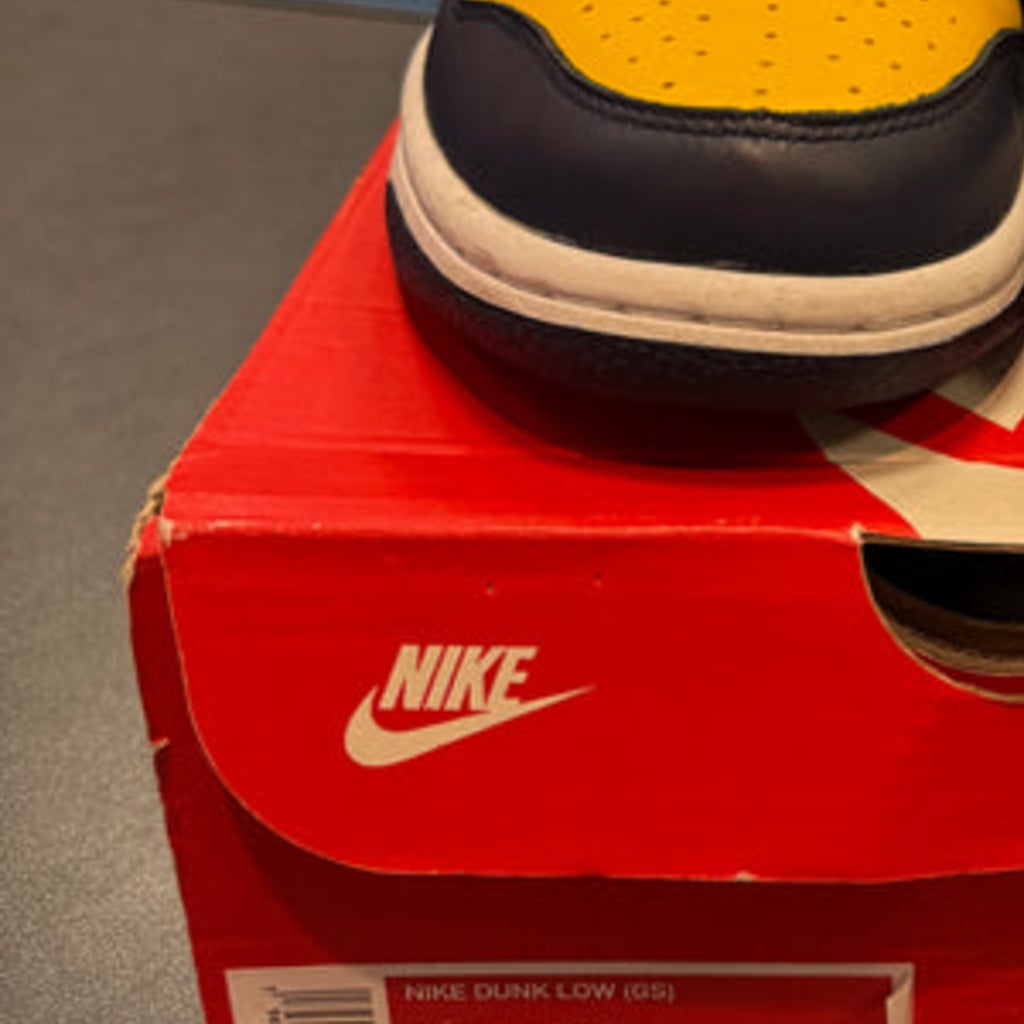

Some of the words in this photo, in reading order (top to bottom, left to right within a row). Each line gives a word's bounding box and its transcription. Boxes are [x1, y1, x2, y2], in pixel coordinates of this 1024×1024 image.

[377, 643, 539, 712] NIKE
[404, 982, 466, 1002] NIKE
[473, 982, 551, 1000] DUNK
[556, 982, 616, 1000] LOW
[622, 981, 676, 1003] (GS)
